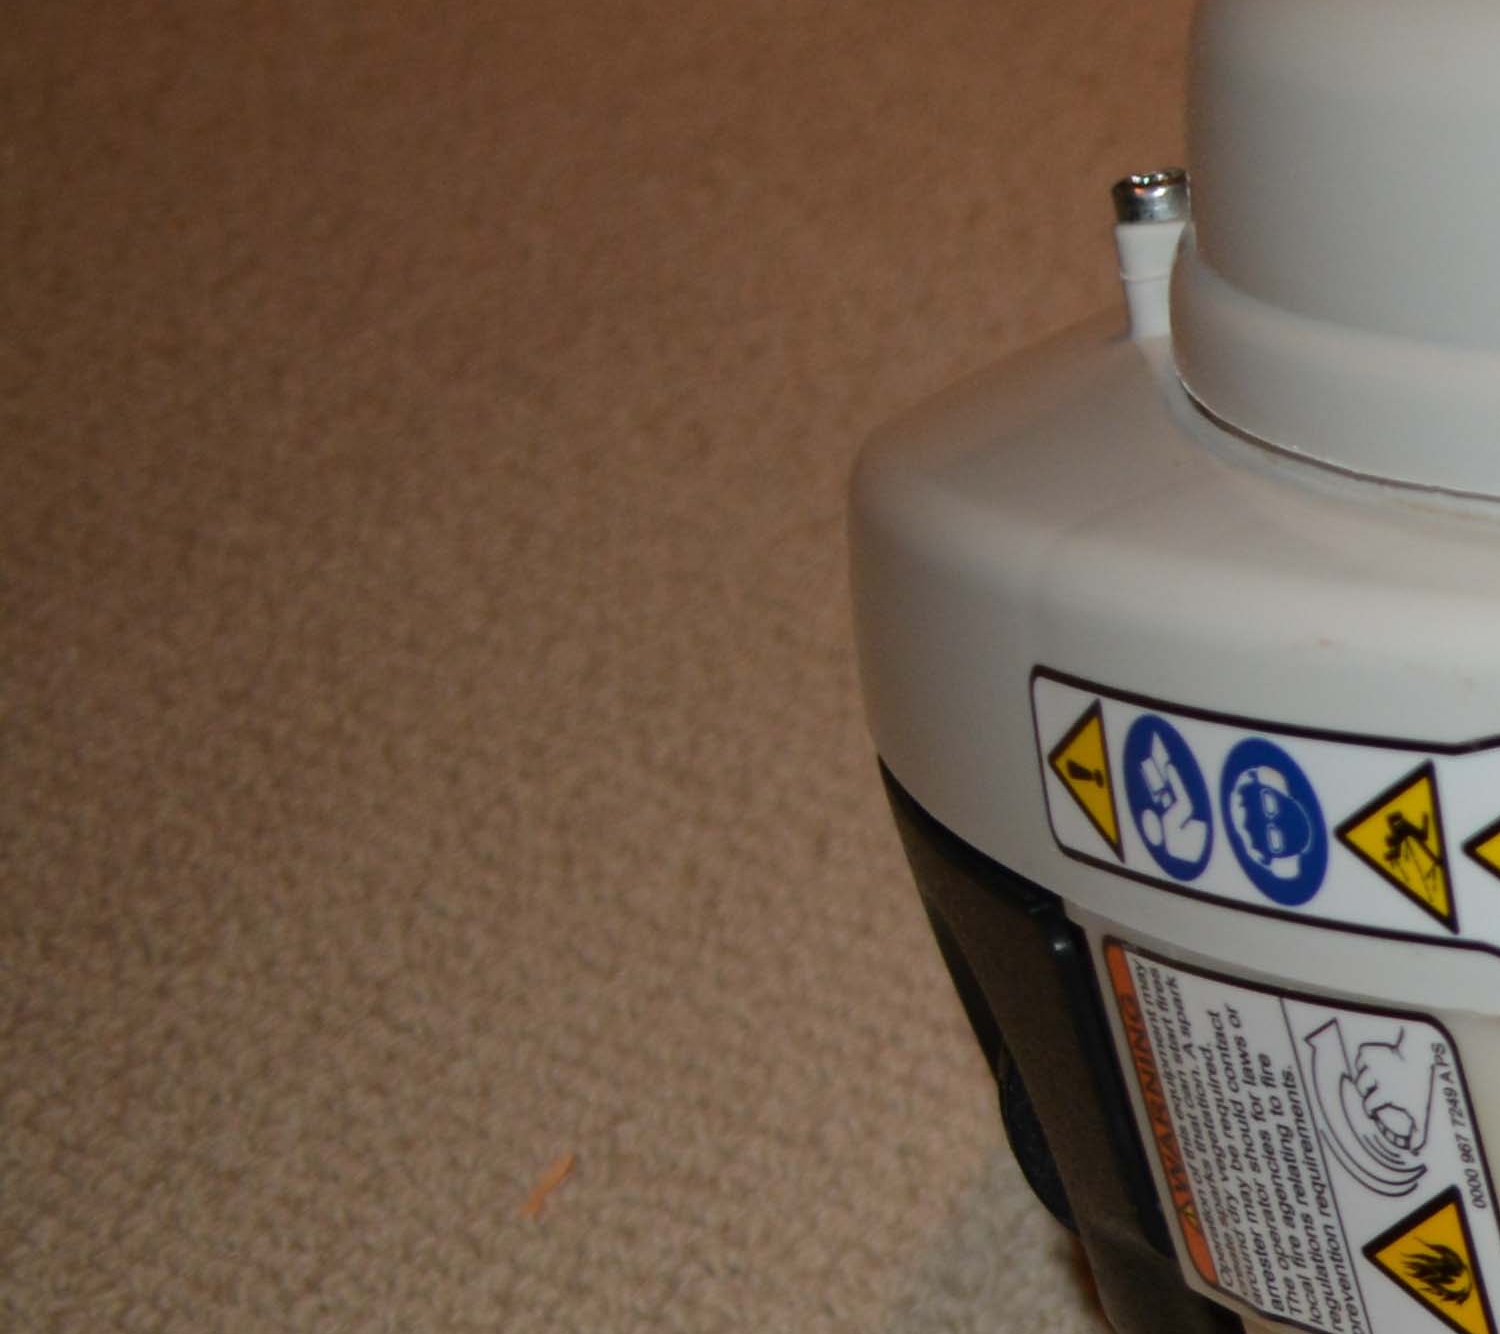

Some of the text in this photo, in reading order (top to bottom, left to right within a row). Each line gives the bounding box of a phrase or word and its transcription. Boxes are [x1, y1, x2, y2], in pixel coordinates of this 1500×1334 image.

[1146, 964, 1170, 1013] fires
[1160, 1016, 1184, 1065] start
[1119, 994, 1189, 1195] WARNING
[1133, 960, 1235, 1288] Operation of this equipment may
[1162, 973, 1264, 1304] around dry vegetation. A spark
[1176, 1068, 1195, 1108] can
[1186, 1111, 1208, 1154] that
[1196, 1038, 1284, 1311] arrester may be required.
[1206, 1007, 1304, 1317] The operator should contact
[1224, 1003, 1324, 1325] local fire agencies for laws or
[1275, 1059, 1337, 1220] requirements.
[1430, 1043, 1487, 1209] 0000 967 7249 A PS
[1199, 1156, 1230, 1229] sparks
[1253, 1049, 1348, 1334] regulations relating to fire
